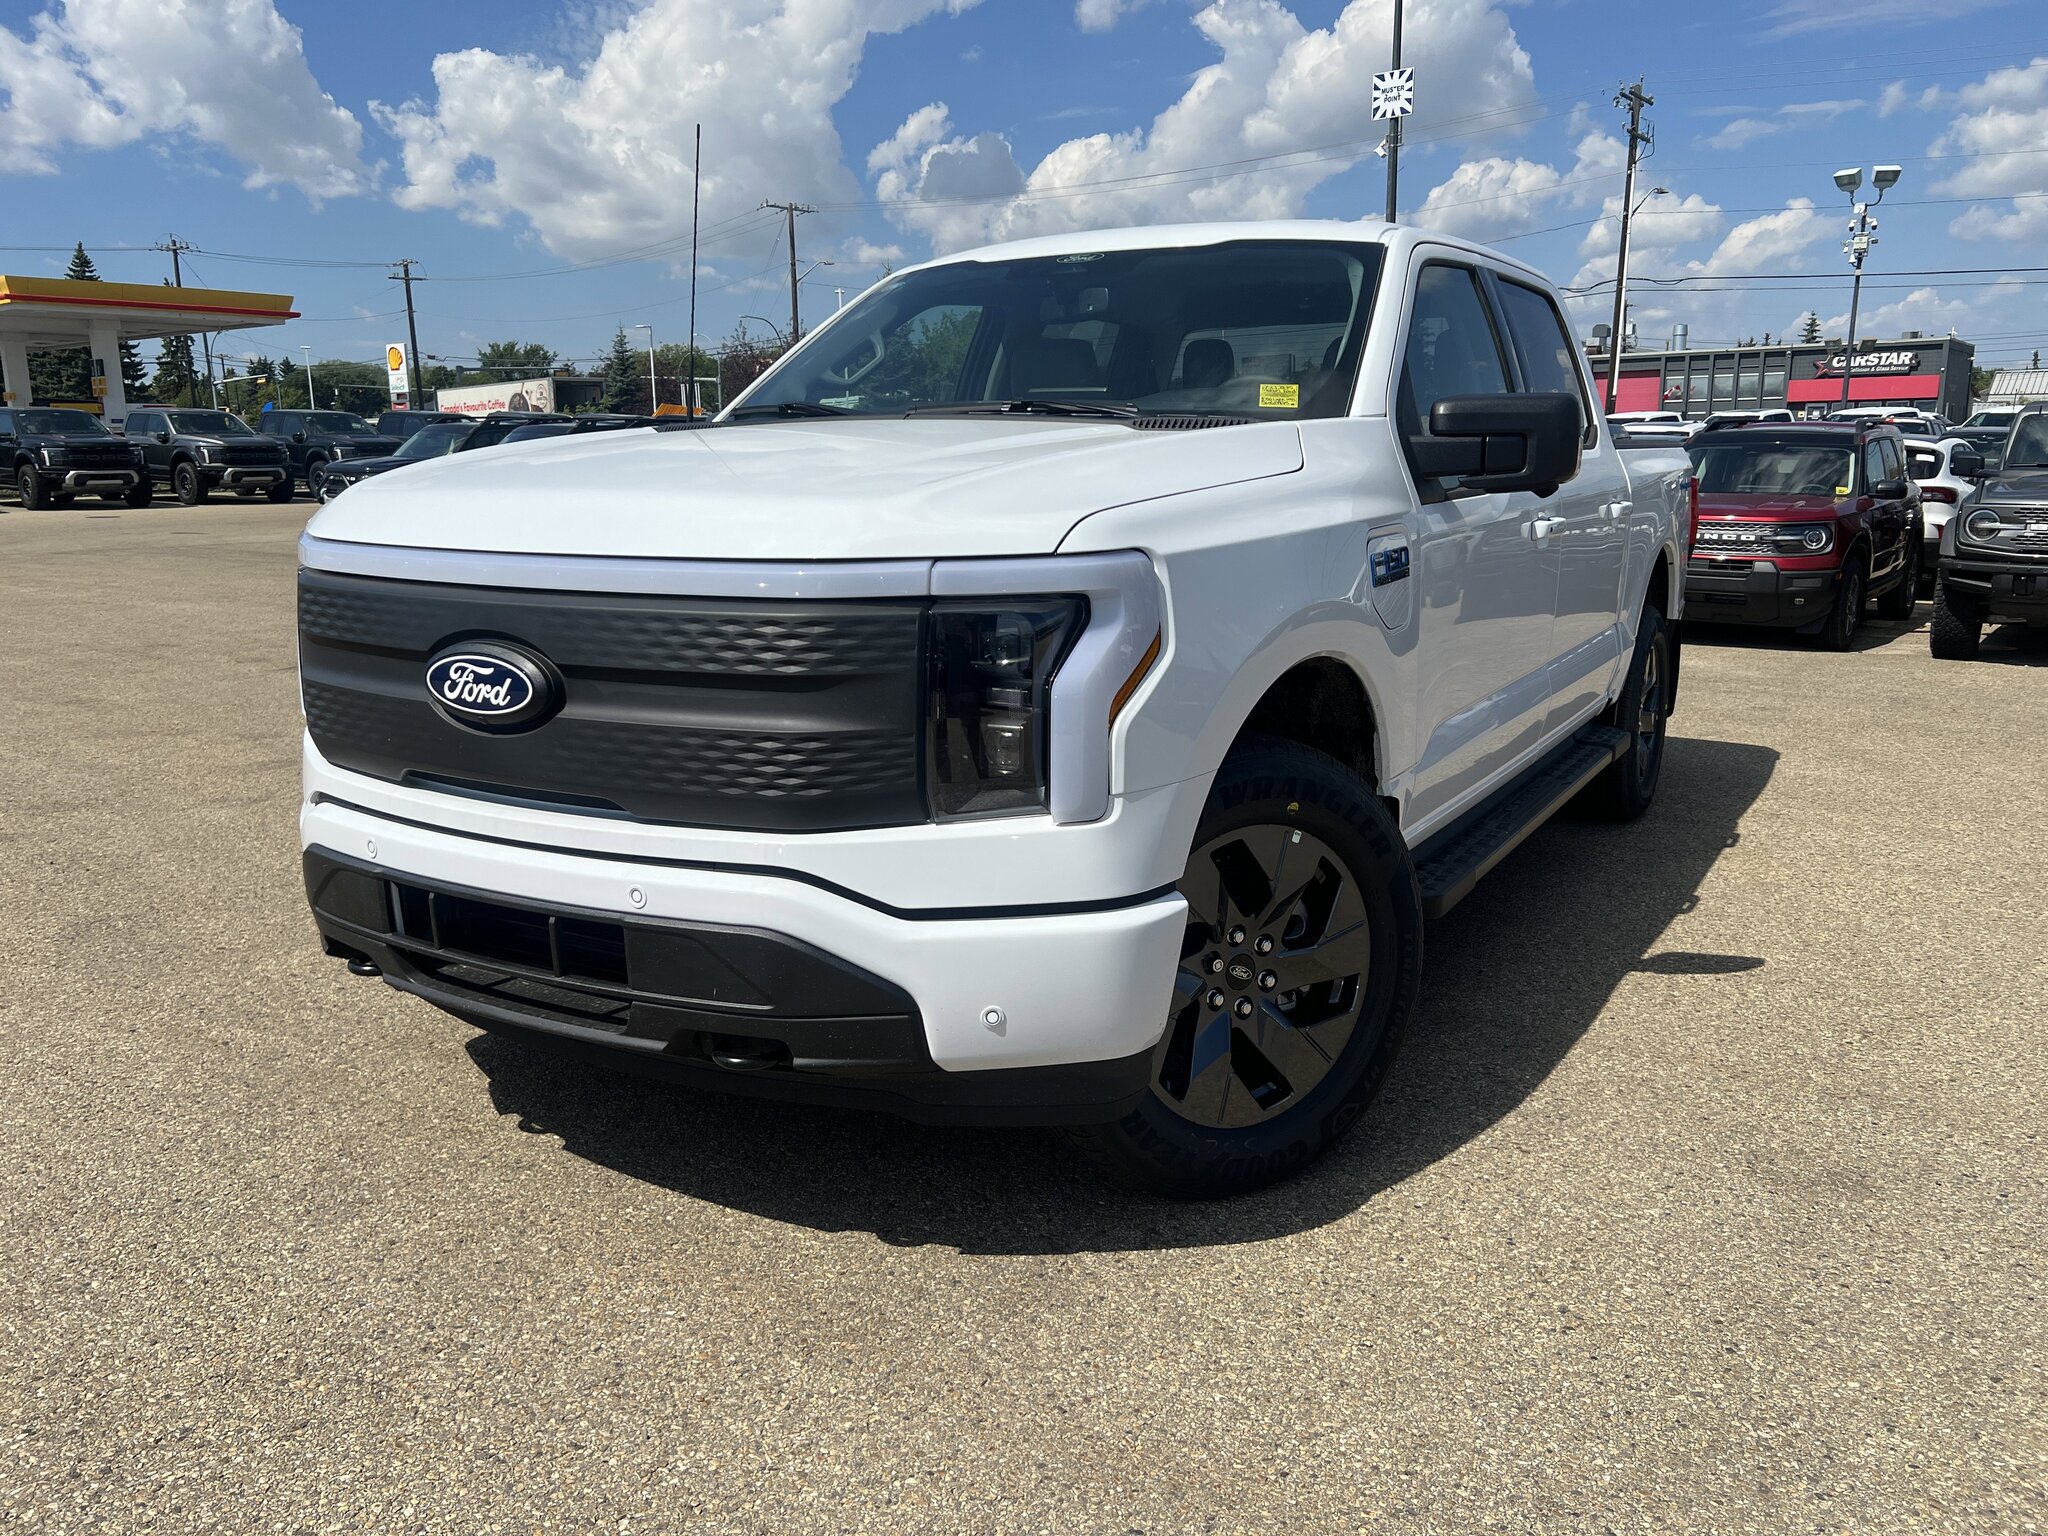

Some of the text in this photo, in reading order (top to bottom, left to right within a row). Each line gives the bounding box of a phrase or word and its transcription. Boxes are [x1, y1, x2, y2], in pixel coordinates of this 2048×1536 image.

[1381, 85, 1405, 94] MUSTER
[1383, 94, 1401, 103] POINT
[1832, 351, 1913, 367] CARSTAR
[440, 399, 506, 413] Canada's Favourite Coffee
[443, 661, 513, 706] Ford
[1218, 775, 1392, 859] WRANGLER
[1232, 967, 1250, 978] Ford
